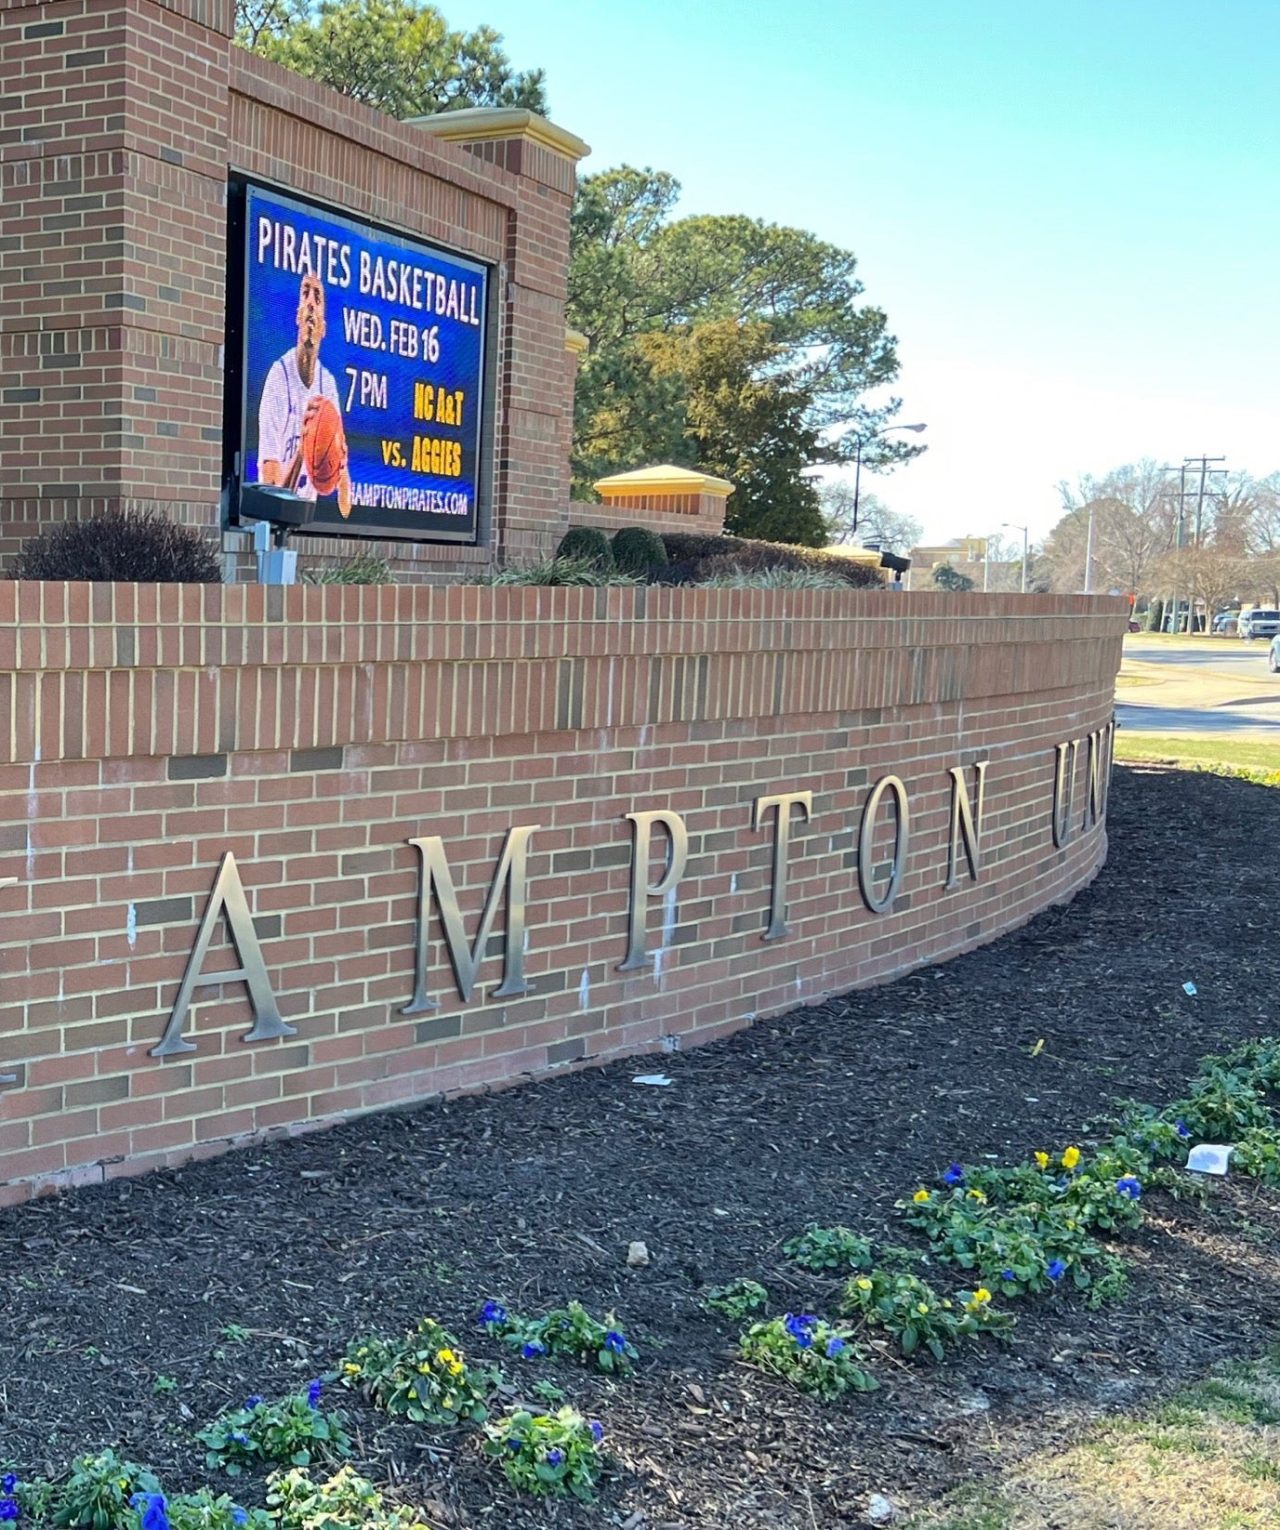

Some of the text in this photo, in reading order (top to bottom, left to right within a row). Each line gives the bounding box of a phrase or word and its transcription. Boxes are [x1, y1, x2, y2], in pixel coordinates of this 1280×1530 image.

[258, 216, 480, 326] PIRATES BASKETBALL
[343, 307, 440, 364] WED. FEB 16
[345, 367, 388, 413] 7 PM
[413, 382, 464, 426] NC A&T
[411, 435, 462, 477] AGGIES
